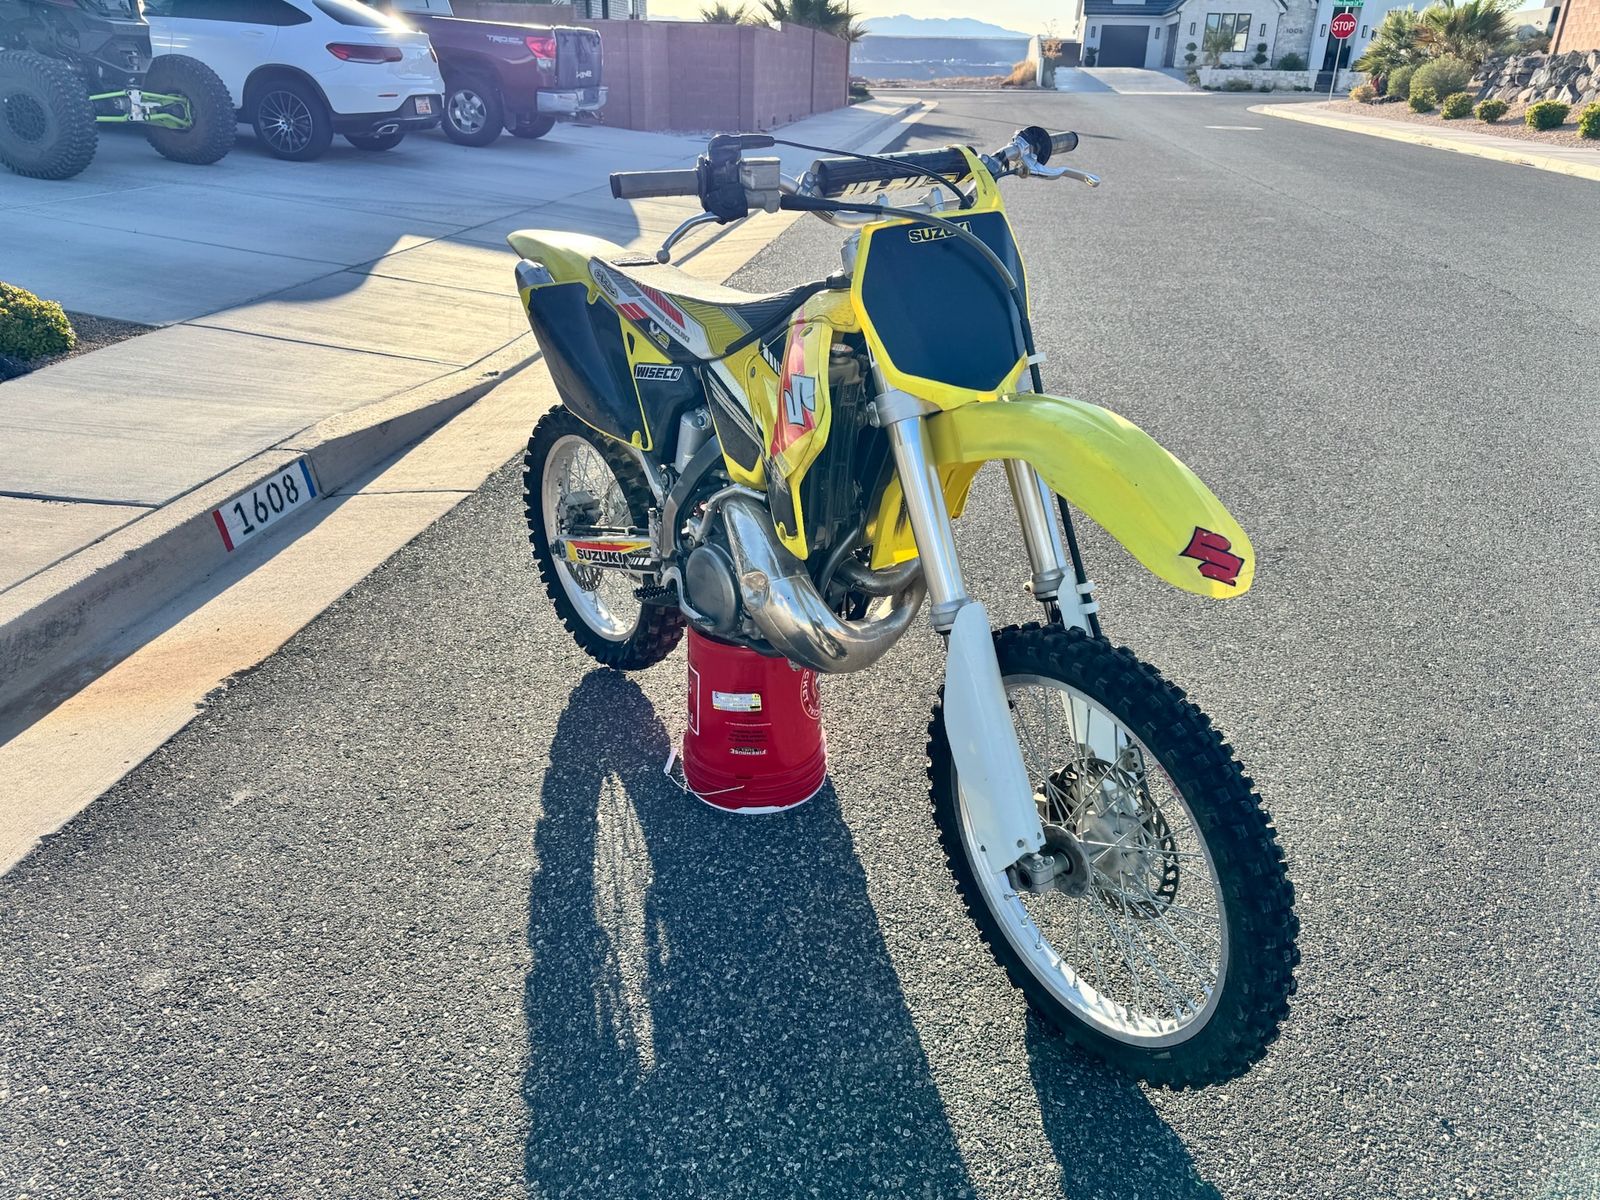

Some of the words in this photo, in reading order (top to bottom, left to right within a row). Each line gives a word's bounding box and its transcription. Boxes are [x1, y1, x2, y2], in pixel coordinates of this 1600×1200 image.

[1333, 21, 1355, 31] STOP
[909, 221, 971, 242] SUZUI
[664, 318, 690, 343] SUZUKI
[635, 366, 681, 380] WISECO
[233, 474, 299, 535] 1608
[576, 548, 623, 563] SUZUKI
